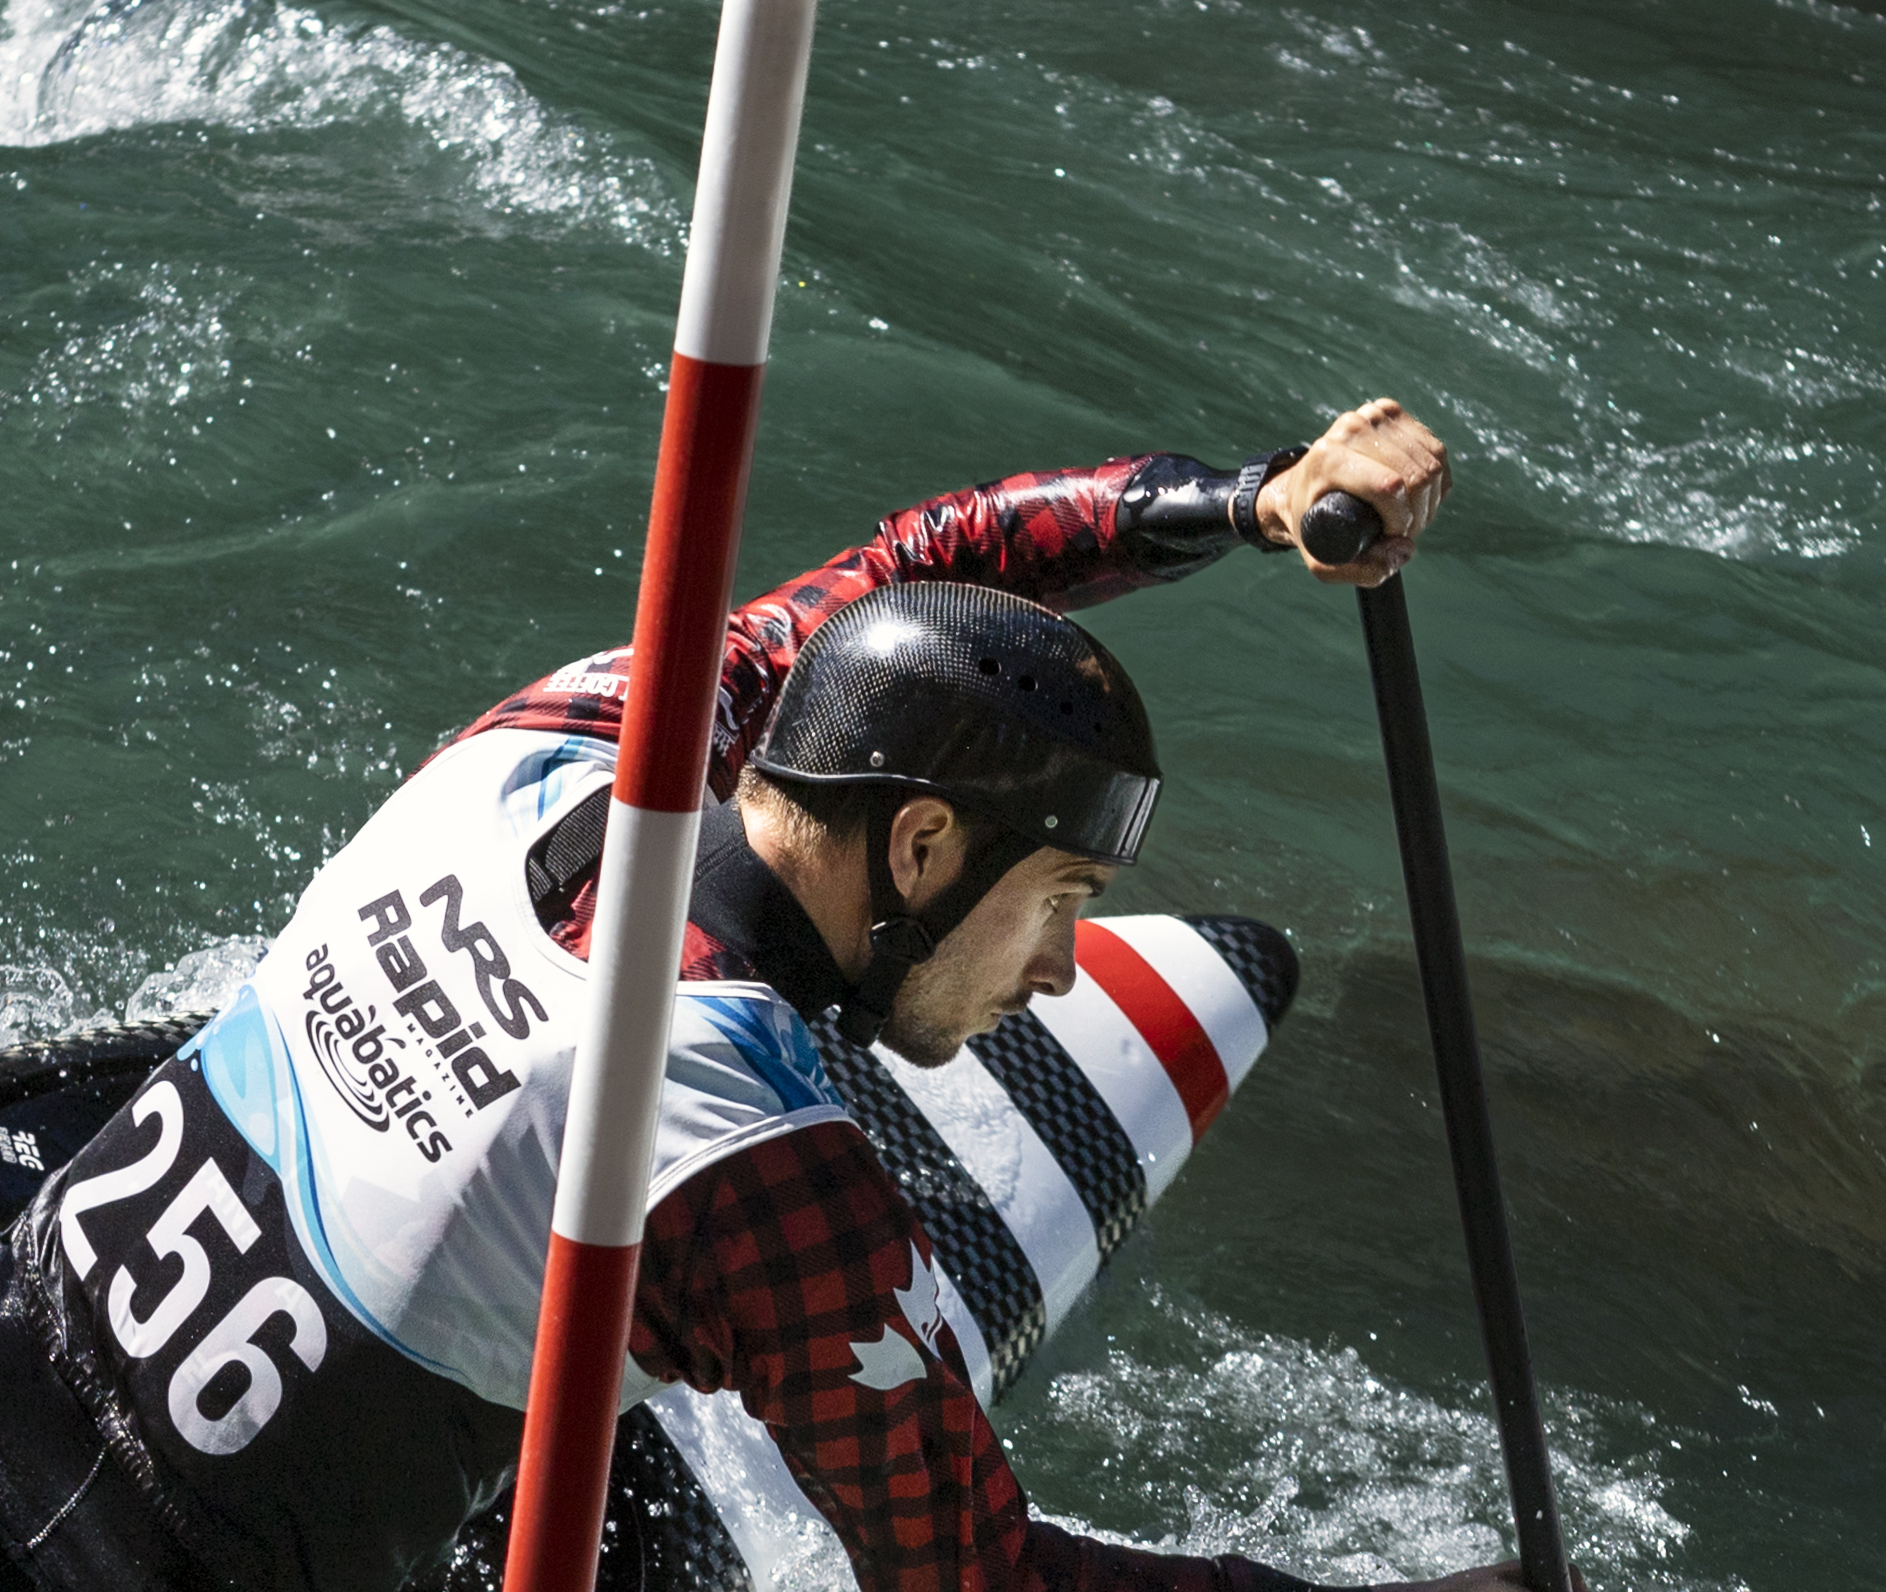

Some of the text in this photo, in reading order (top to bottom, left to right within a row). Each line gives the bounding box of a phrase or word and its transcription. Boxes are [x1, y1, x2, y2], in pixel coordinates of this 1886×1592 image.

[303, 943, 453, 1163] aquabatics
[357, 889, 522, 1111] Rapid
[419, 874, 549, 1040] NRS
[407, 1023, 474, 1118] MAGAZINE
[59, 1080, 327, 1455] 256
